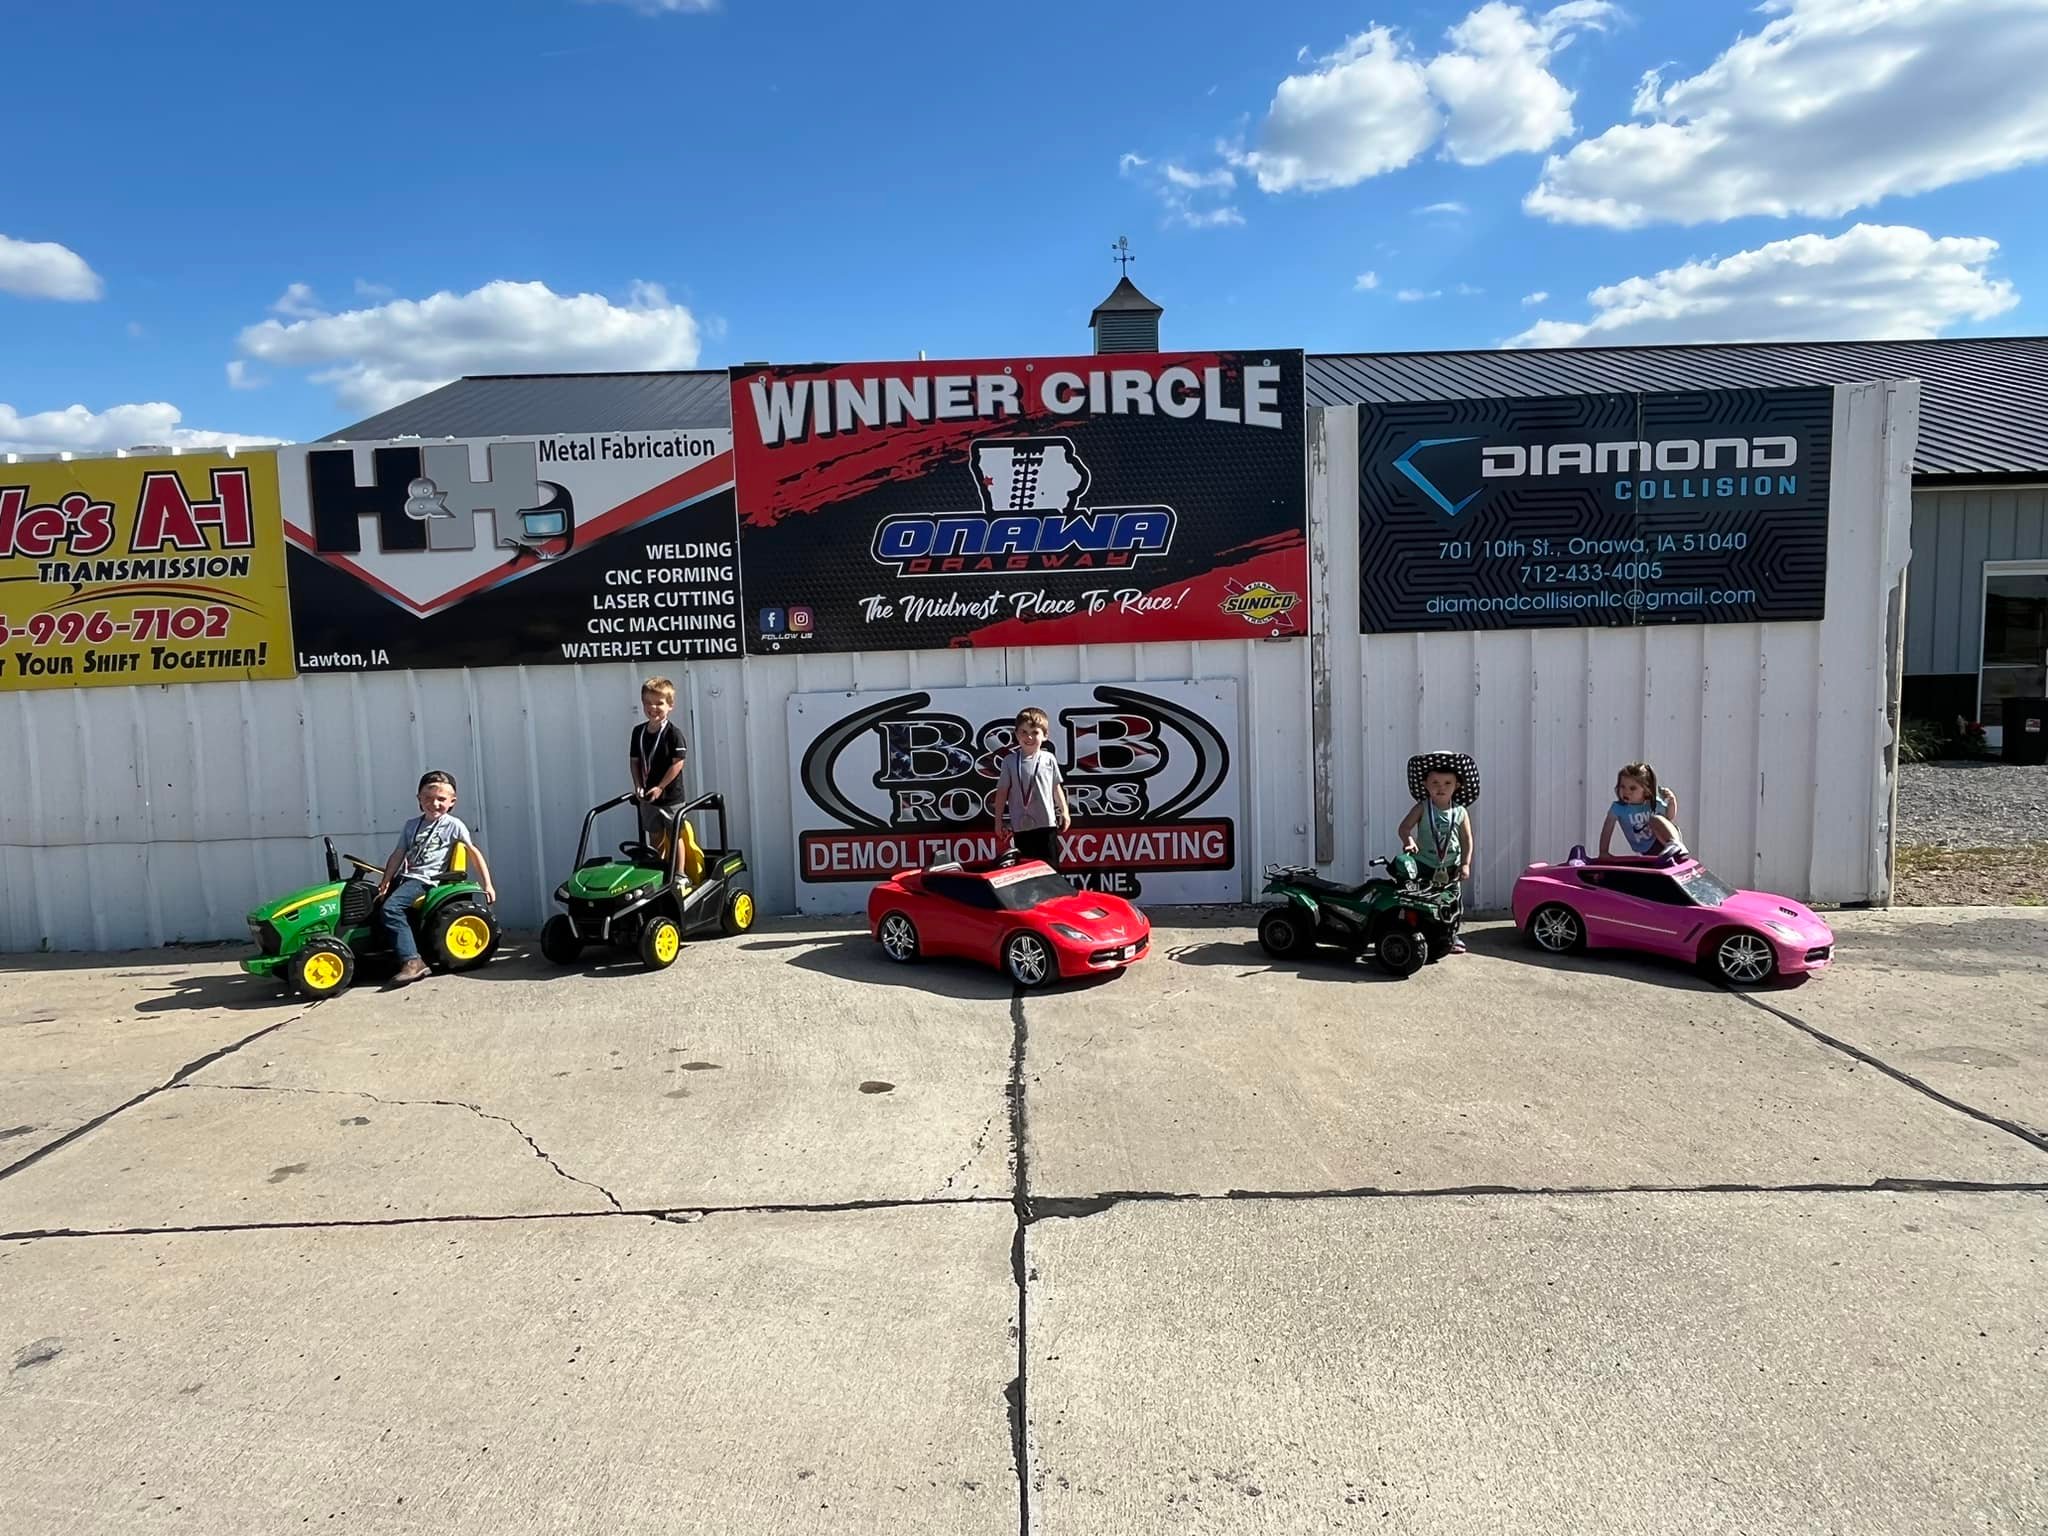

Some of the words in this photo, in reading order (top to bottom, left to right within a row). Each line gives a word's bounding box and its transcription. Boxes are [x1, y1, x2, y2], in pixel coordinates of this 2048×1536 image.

[749, 374, 1020, 447] WINNER
[1041, 365, 1284, 430] CIRCLE
[539, 437, 595, 462] Metal
[601, 435, 715, 459] Fabrication
[1481, 436, 1797, 477] DIAMOND
[310, 445, 540, 553] H&H
[1615, 475, 1797, 500] COLLISION
[129, 467, 255, 554] A-1
[877, 512, 1170, 557] ONAWA
[1438, 542, 1471, 560] 701
[1484, 539, 1524, 558] 10th
[1531, 538, 1560, 558] St.,
[1569, 538, 1649, 556] Onawa,
[1657, 535, 1676, 552] IA
[1682, 532, 1747, 552] 51040
[646, 542, 732, 560] WELDING
[907, 552, 1129, 573] DRAGWAY
[38, 556, 250, 586] TRANSMISSION
[605, 569, 642, 585] CNC
[647, 566, 733, 584] FORMING
[1520, 563, 1662, 584] 712-433-4005
[593, 593, 650, 610] LASER
[654, 590, 735, 608] CUTTING
[859, 595, 893, 623] The
[898, 591, 1001, 621] Midwest
[1008, 590, 1075, 616] Place
[1081, 588, 1108, 613] To
[1113, 587, 1190, 612] Race!
[1226, 595, 1294, 611] SUNOCO
[1426, 588, 1755, 615] diamondcollisionllc@gmail.com
[587, 618, 625, 634] CNC
[629, 615, 736, 632] MACHINING
[299, 651, 367, 668] Lawton,
[371, 649, 389, 665] IA
[562, 640, 652, 659] WATERJET
[656, 638, 738, 656] CUTTING
[897, 785, 1142, 823] RORS
[810, 837, 996, 871] DEMOLITION
[1057, 829, 1225, 861] XCAVATING
[1100, 872, 1133, 892] NE.
